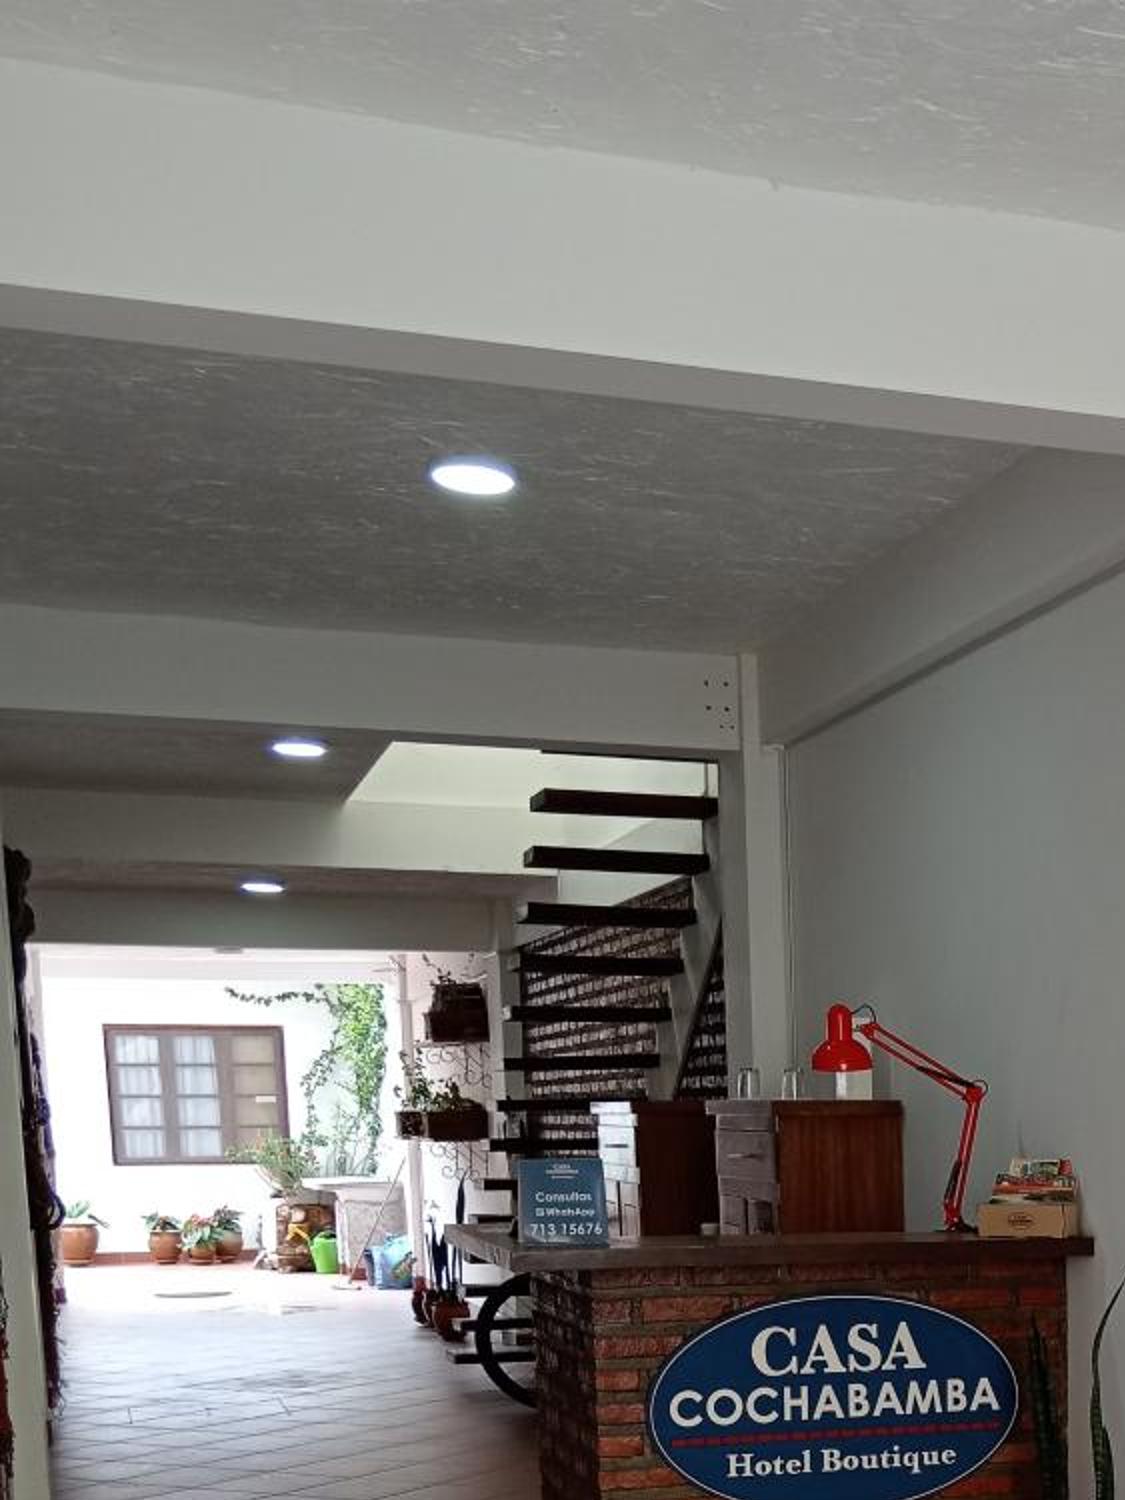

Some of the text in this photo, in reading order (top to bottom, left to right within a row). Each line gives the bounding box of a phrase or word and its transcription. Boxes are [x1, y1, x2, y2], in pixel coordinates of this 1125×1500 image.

[535, 1191, 593, 1204] Consultas
[545, 1207, 595, 1218] WhatsApp
[530, 1222, 603, 1237] 713 15676
[751, 1321, 926, 1377] CASA
[669, 1377, 1000, 1427] COCHABAMBA
[727, 1446, 957, 1478] Hotel Boutique
